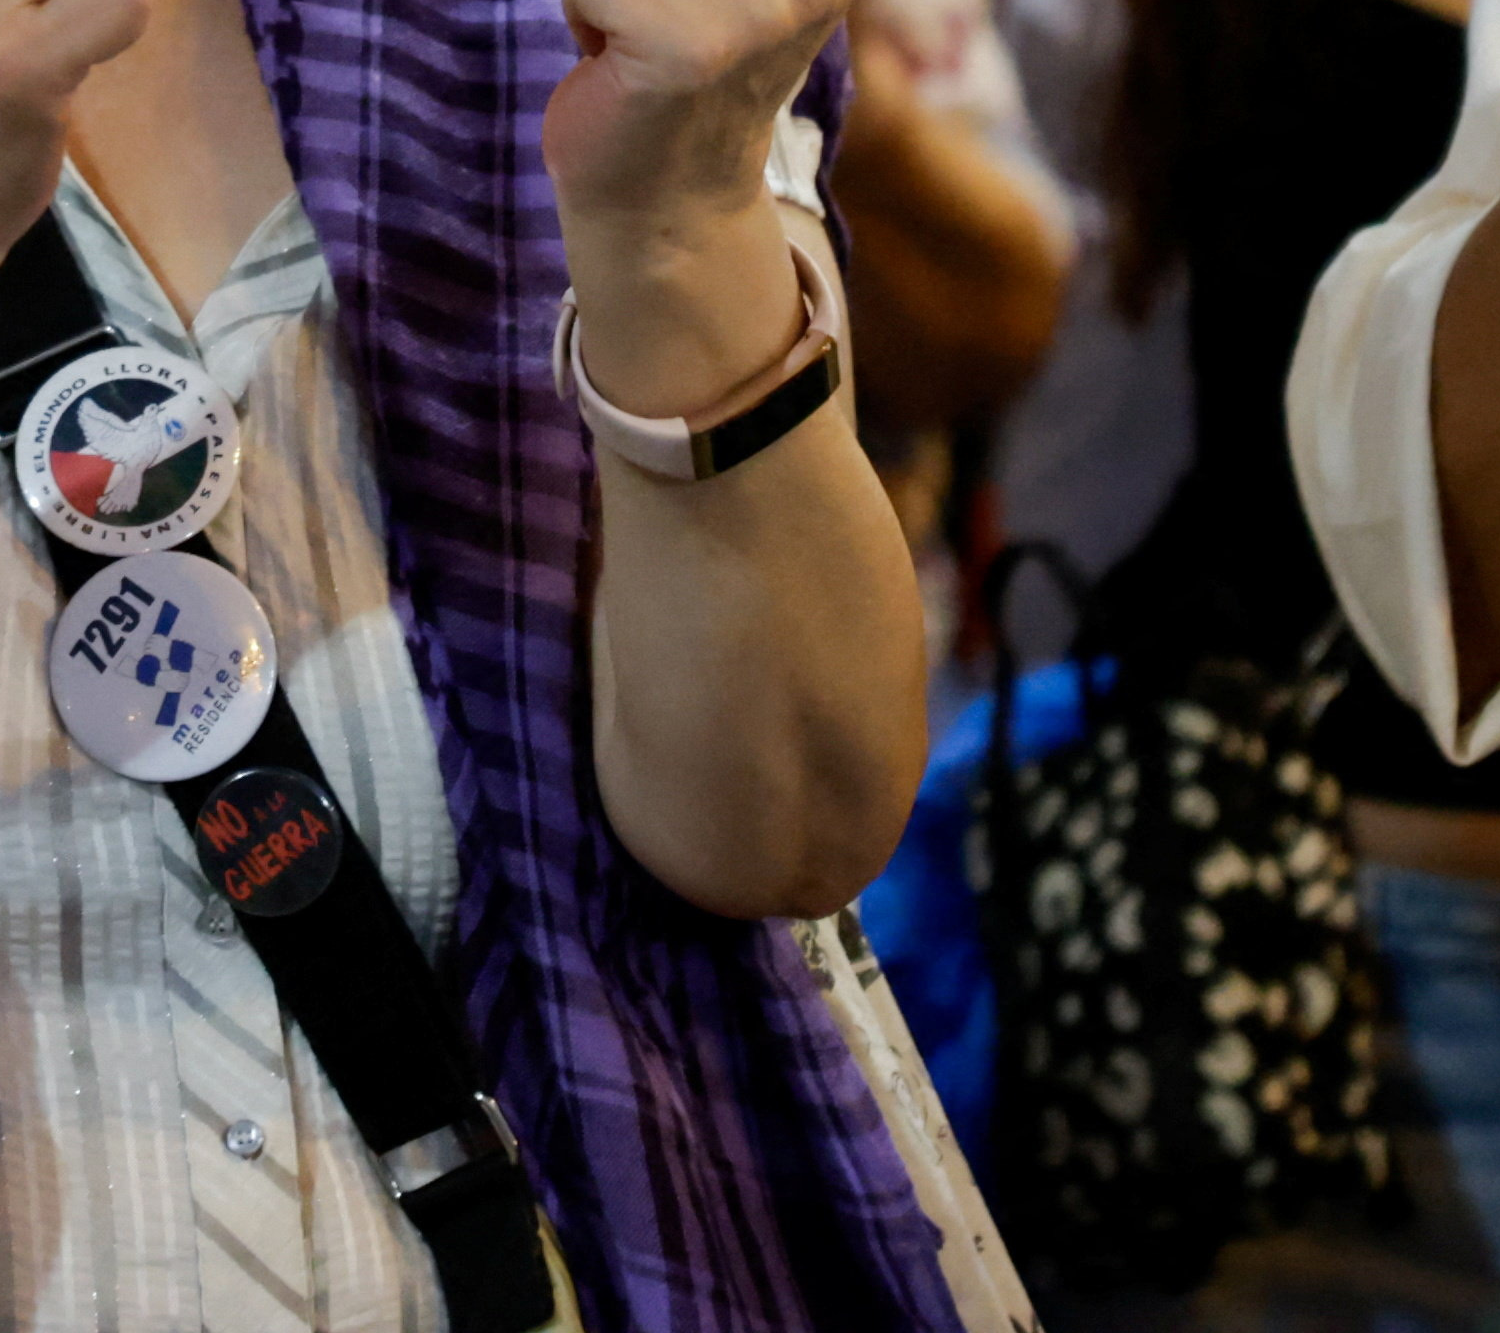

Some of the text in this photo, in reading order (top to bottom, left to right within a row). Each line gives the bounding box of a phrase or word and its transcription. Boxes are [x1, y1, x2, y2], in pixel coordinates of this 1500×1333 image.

[103, 363, 189, 392] LLORA
[34, 378, 88, 445] MUNDO
[32, 451, 45, 474] EL
[68, 575, 156, 675] 7291
[171, 648, 243, 745] marea
[198, 798, 249, 853] NO
[223, 808, 329, 902] GUERRA
